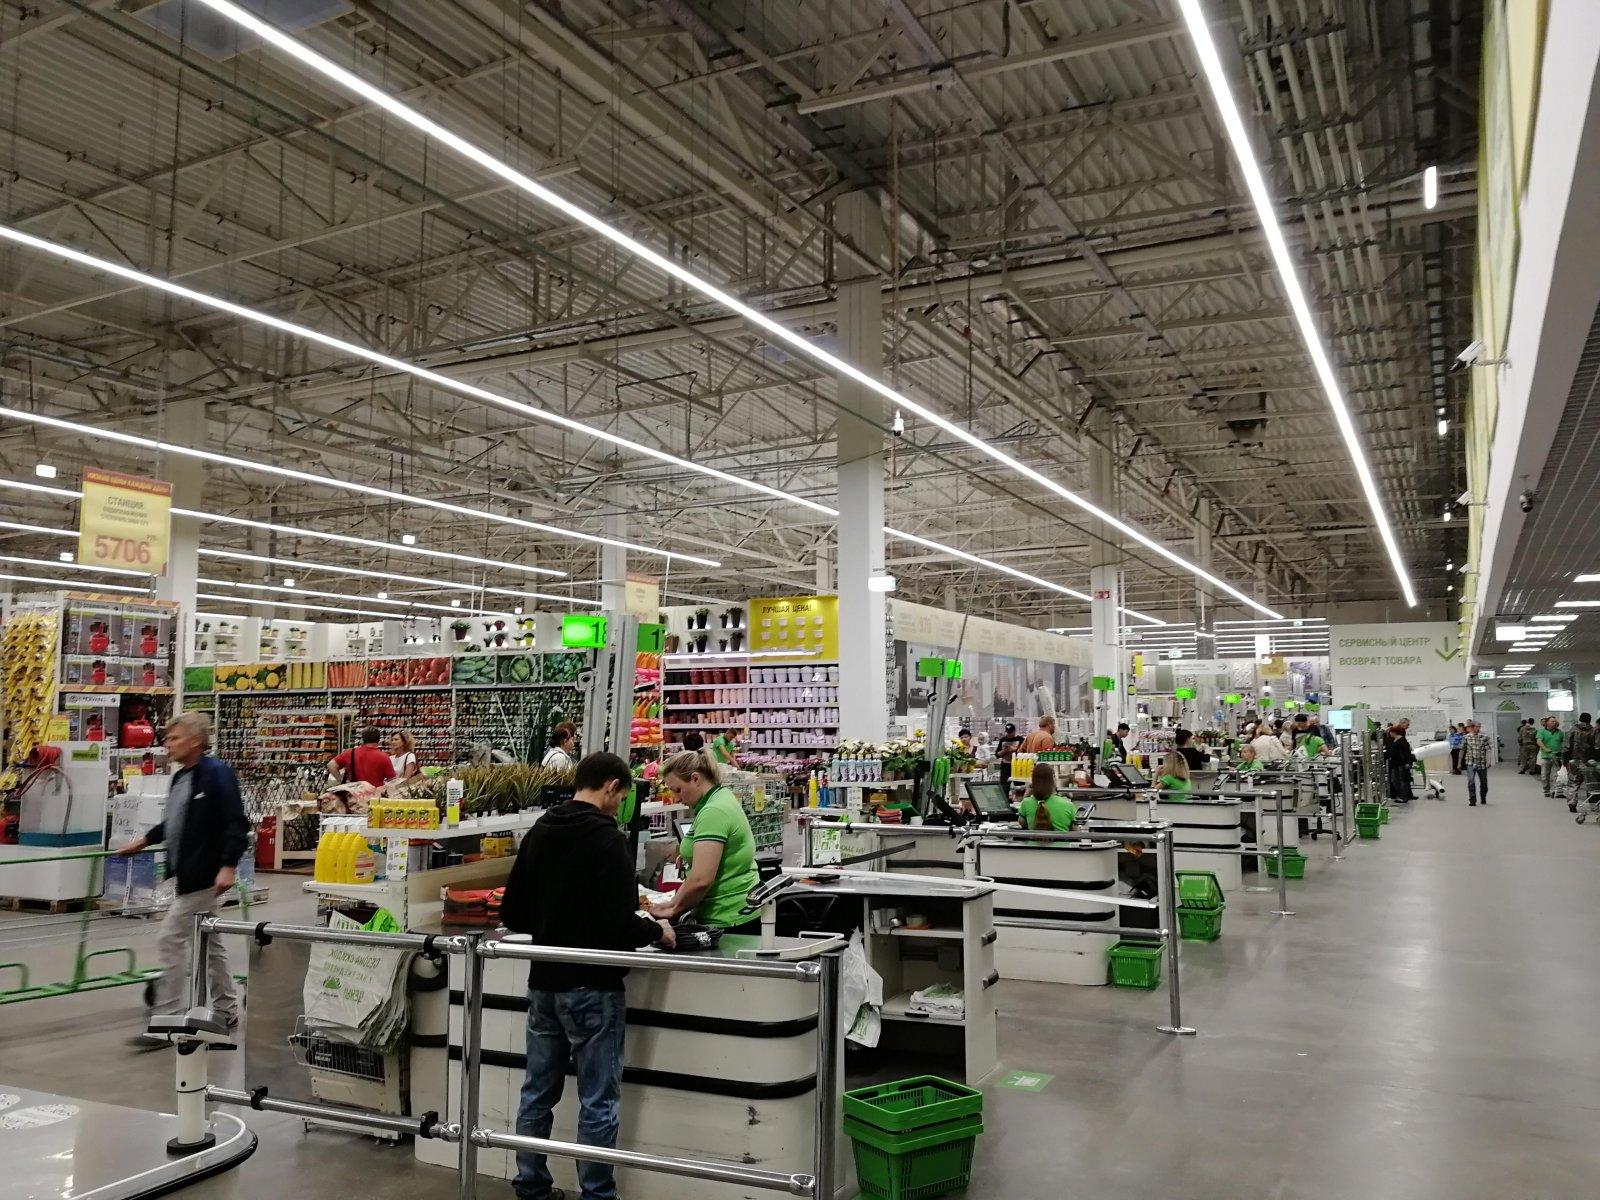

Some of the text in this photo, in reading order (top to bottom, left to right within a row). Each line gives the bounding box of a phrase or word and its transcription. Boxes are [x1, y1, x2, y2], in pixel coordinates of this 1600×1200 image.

[95, 534, 151, 565] 5706
[762, 603, 812, 614] ЛУЧШАЯ ЦЕНА!
[651, 628, 666, 650] 1
[1399, 637, 1431, 648] ЦЕНТР
[1339, 656, 1422, 666] ВОЗВРАТ ТОВАРА
[1516, 681, 1539, 690] ВХОД
